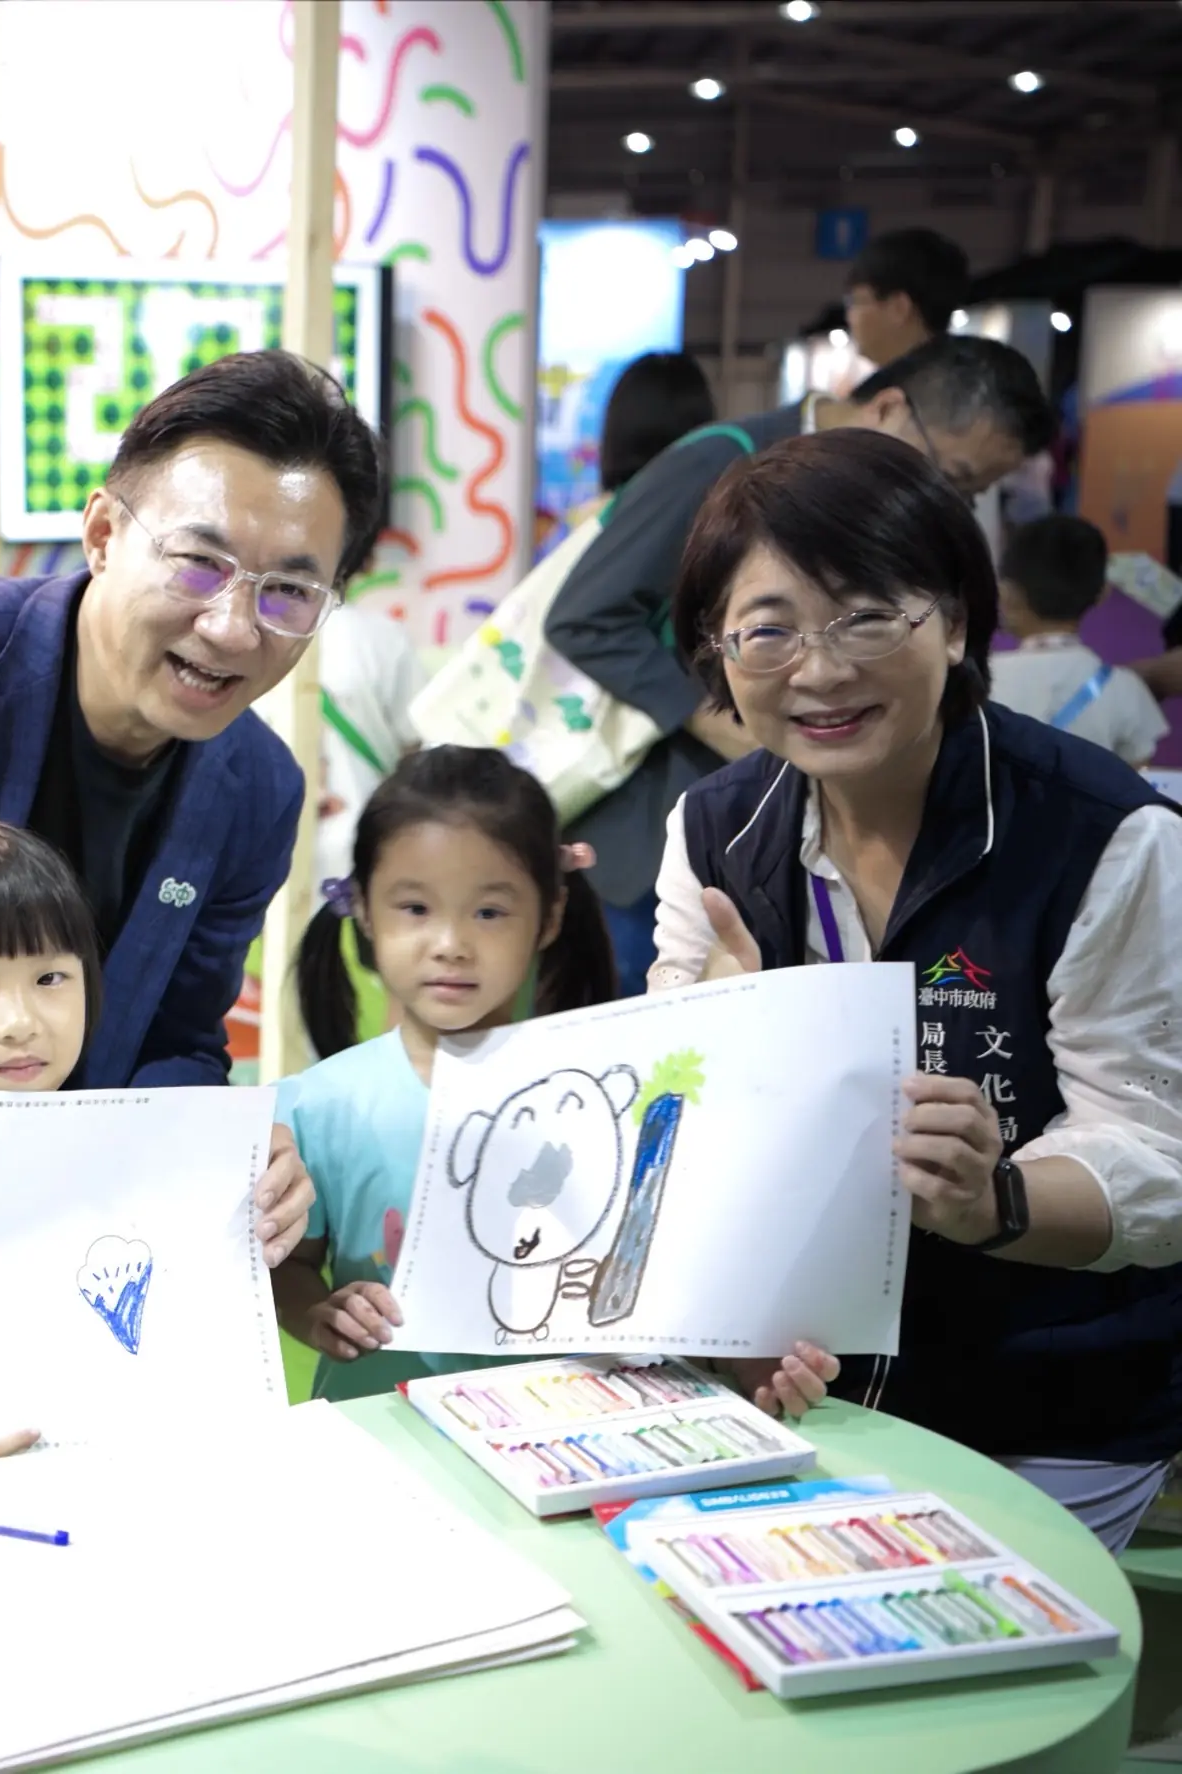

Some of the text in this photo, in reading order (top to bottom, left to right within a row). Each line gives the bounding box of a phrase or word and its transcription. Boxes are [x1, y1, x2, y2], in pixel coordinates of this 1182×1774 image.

[918, 987, 997, 1009] 臺中市政府
[920, 1021, 948, 1074] 局長
